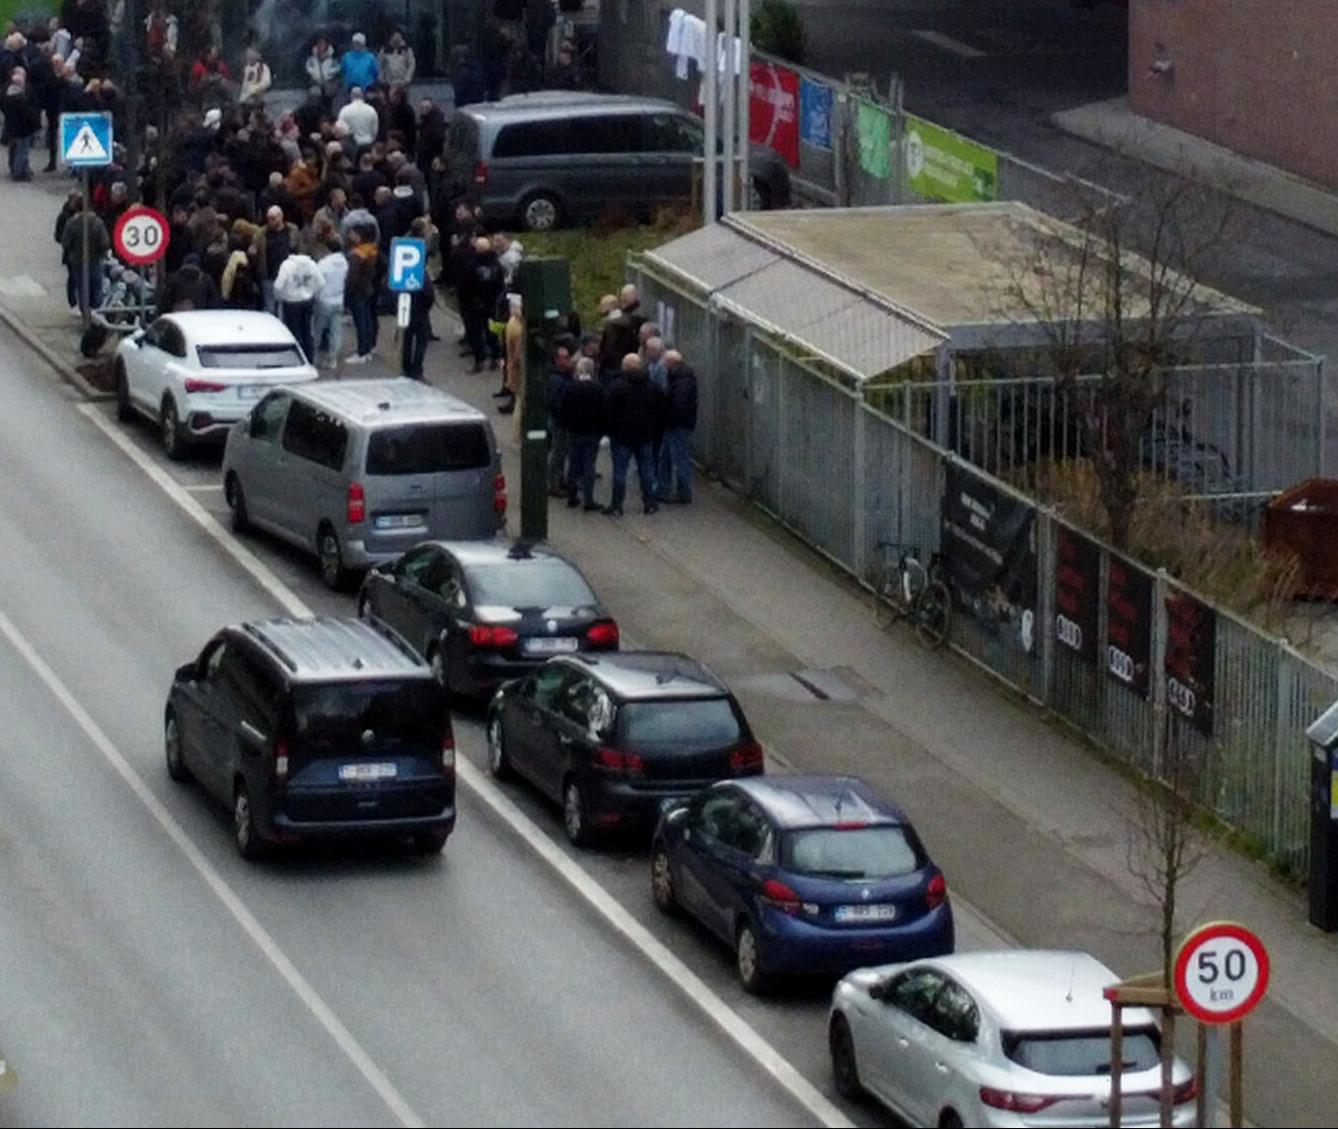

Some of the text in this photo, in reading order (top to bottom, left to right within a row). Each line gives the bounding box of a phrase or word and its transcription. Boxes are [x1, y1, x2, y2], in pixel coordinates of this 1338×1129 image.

[126, 224, 159, 248] 30
[393, 244, 421, 282] P
[1198, 949, 1246, 984] 50
